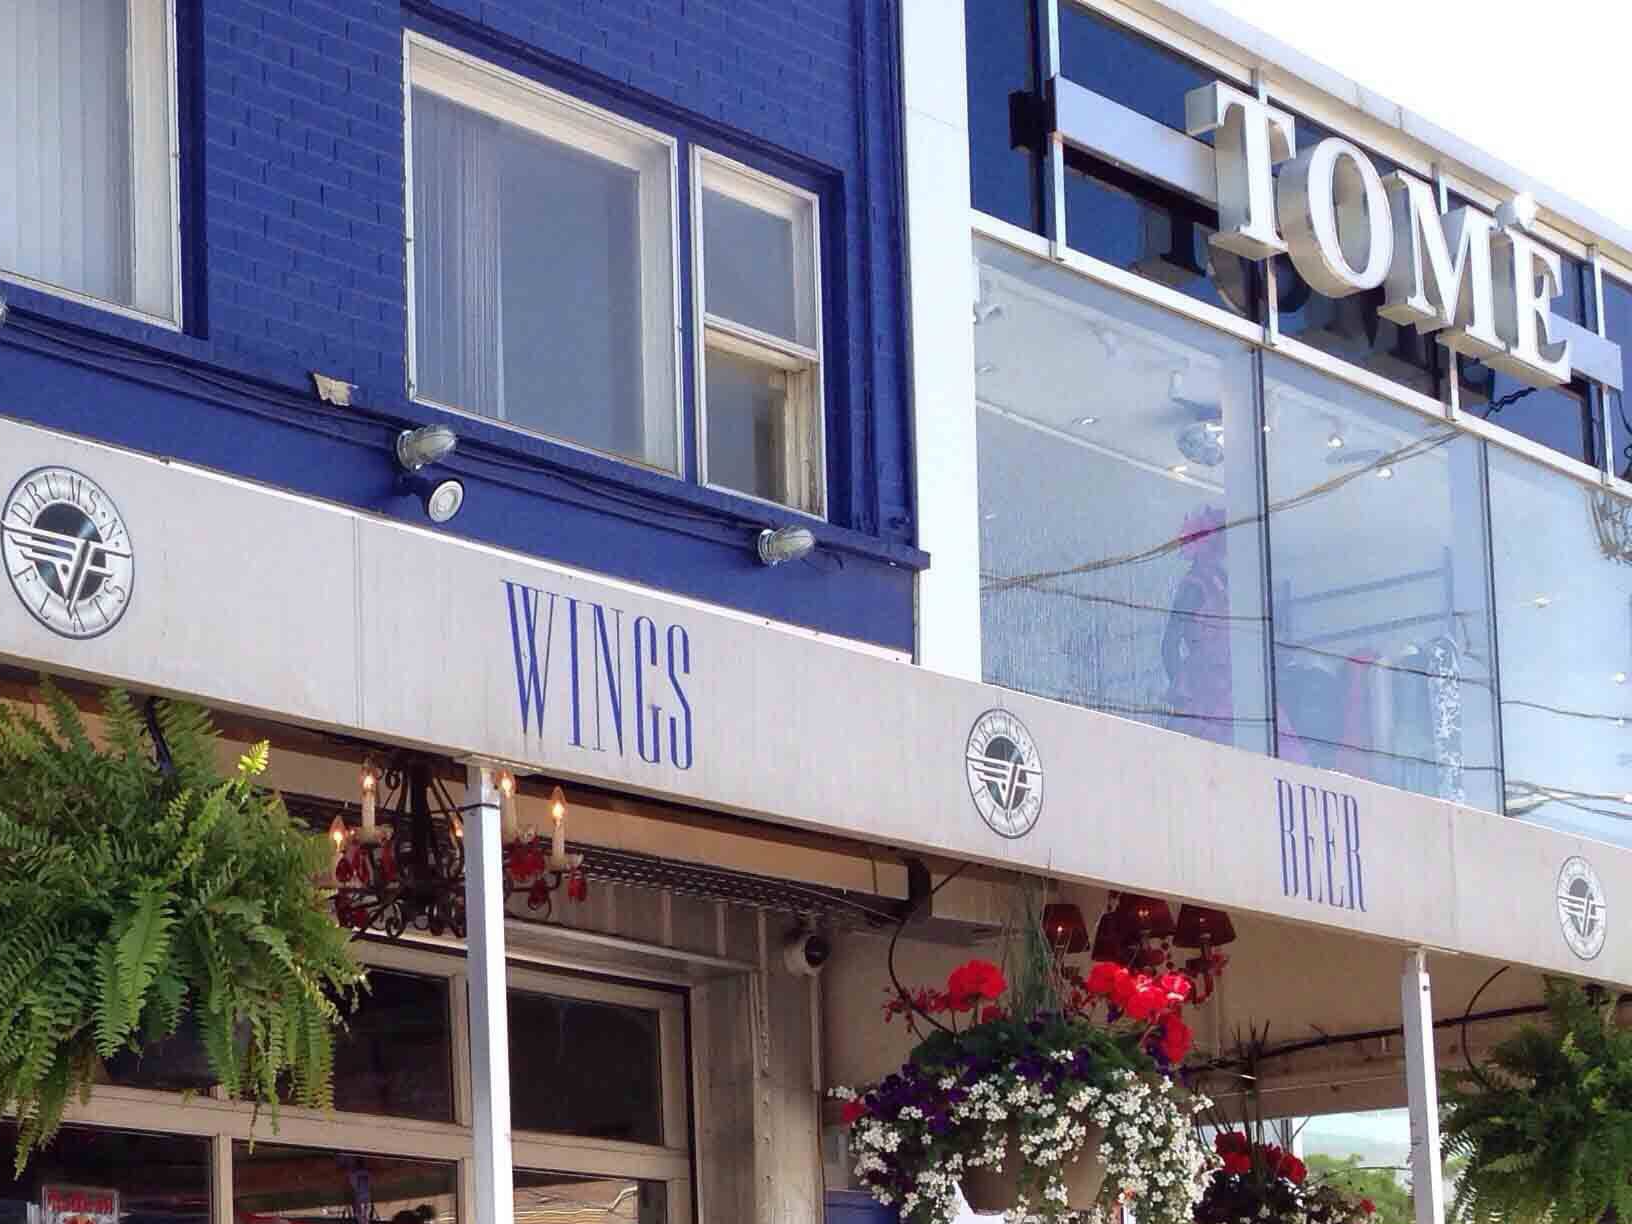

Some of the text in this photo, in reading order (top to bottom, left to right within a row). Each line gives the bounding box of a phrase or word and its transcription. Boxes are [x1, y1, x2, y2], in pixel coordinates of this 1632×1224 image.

[1185, 80, 1571, 384] TOMÉ
[501, 579, 694, 771] WINGS
[1273, 778, 1368, 913] BEER
